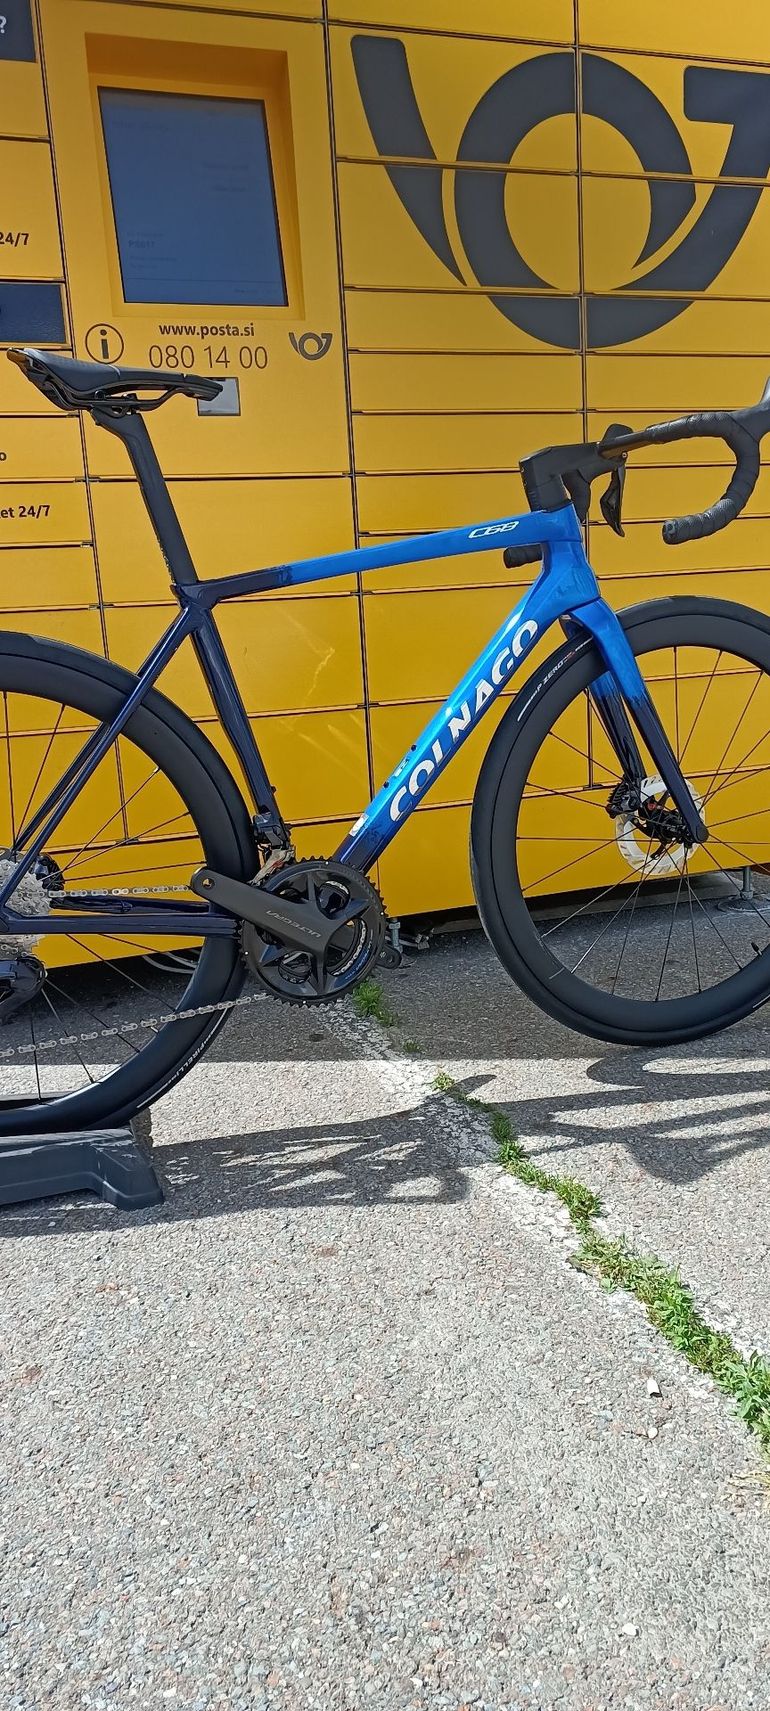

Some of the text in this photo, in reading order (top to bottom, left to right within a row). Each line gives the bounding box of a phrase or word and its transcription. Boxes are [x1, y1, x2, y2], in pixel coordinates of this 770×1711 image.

[158, 322, 255, 340] www.posta.si
[148, 344, 268, 369] 080 14 00
[0, 504, 51, 519] et 24/7
[389, 619, 539, 822] COLNAGO
[265, 909, 322, 938] ULTEGRA
[175, 1041, 206, 1077] PIRELLI
